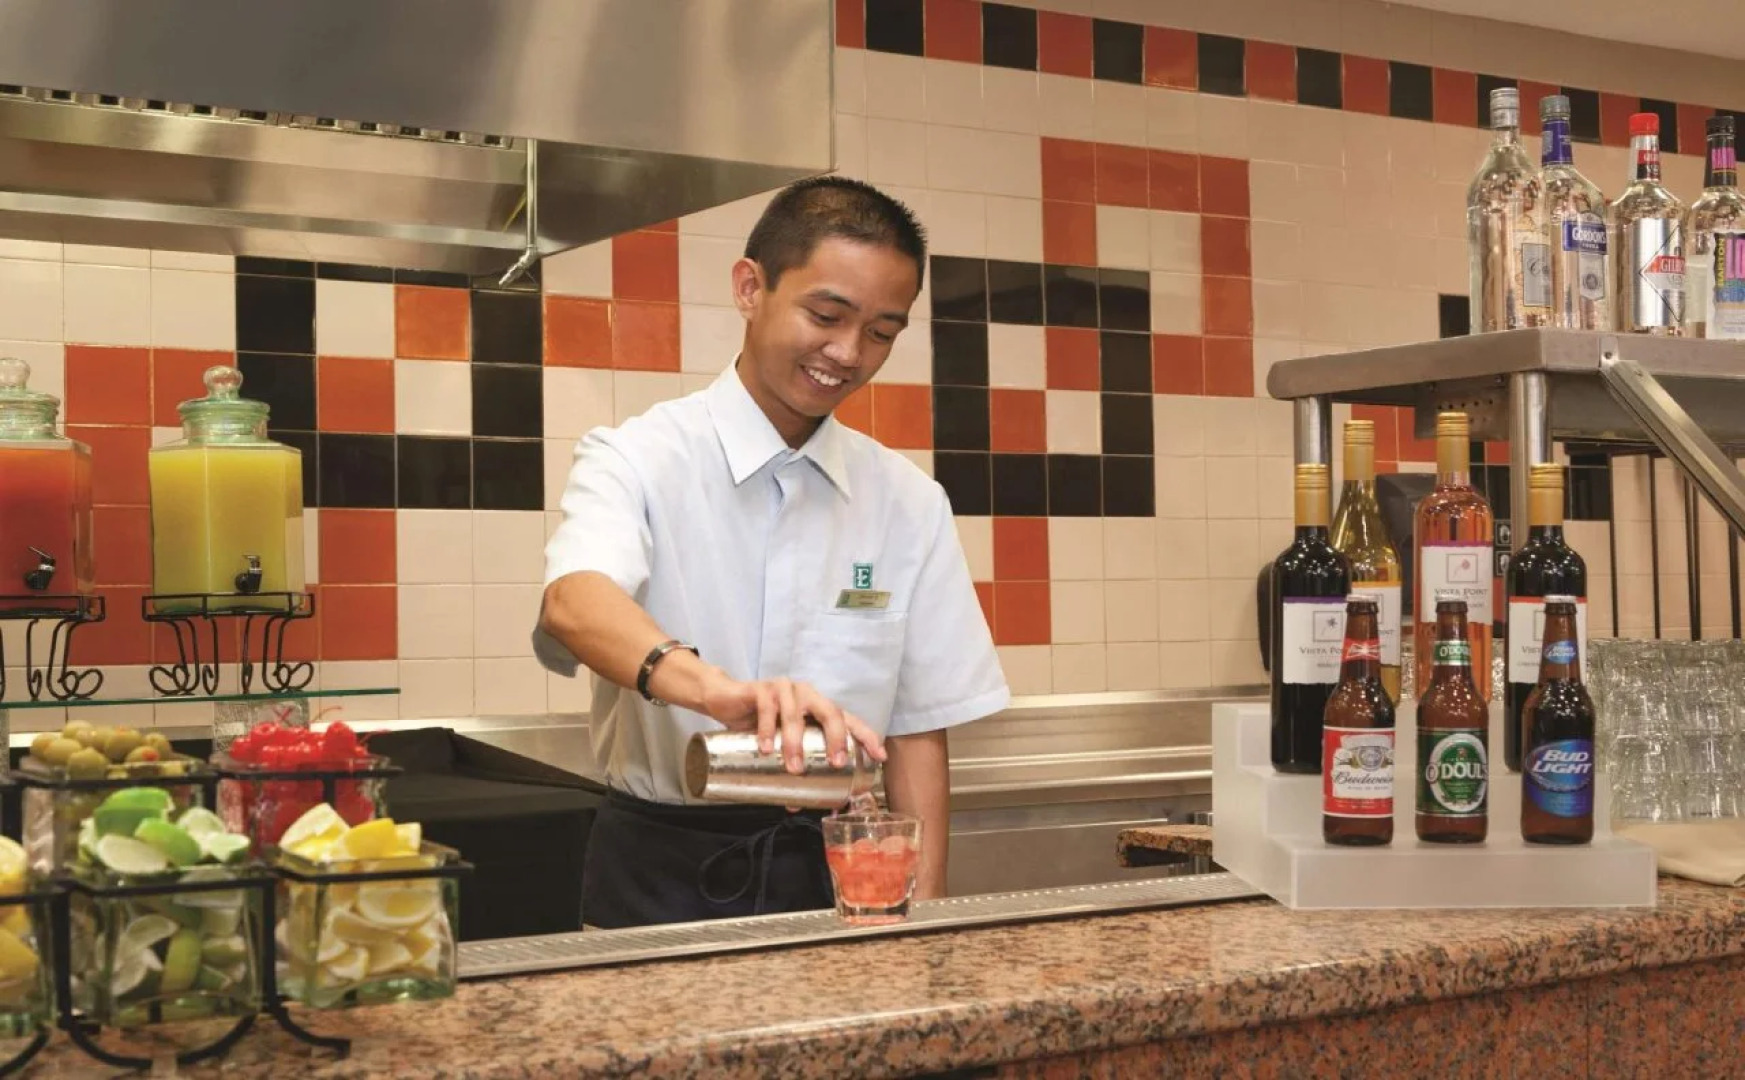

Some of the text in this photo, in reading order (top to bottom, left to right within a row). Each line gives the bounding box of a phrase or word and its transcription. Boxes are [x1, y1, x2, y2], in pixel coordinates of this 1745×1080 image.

[1717, 239, 1725, 288] BARTON
[1434, 588, 1488, 596] VISTA POINT
[1299, 646, 1328, 655] VISTA
[1542, 749, 1588, 762] BUD
[1532, 762, 1592, 774] LIGHT
